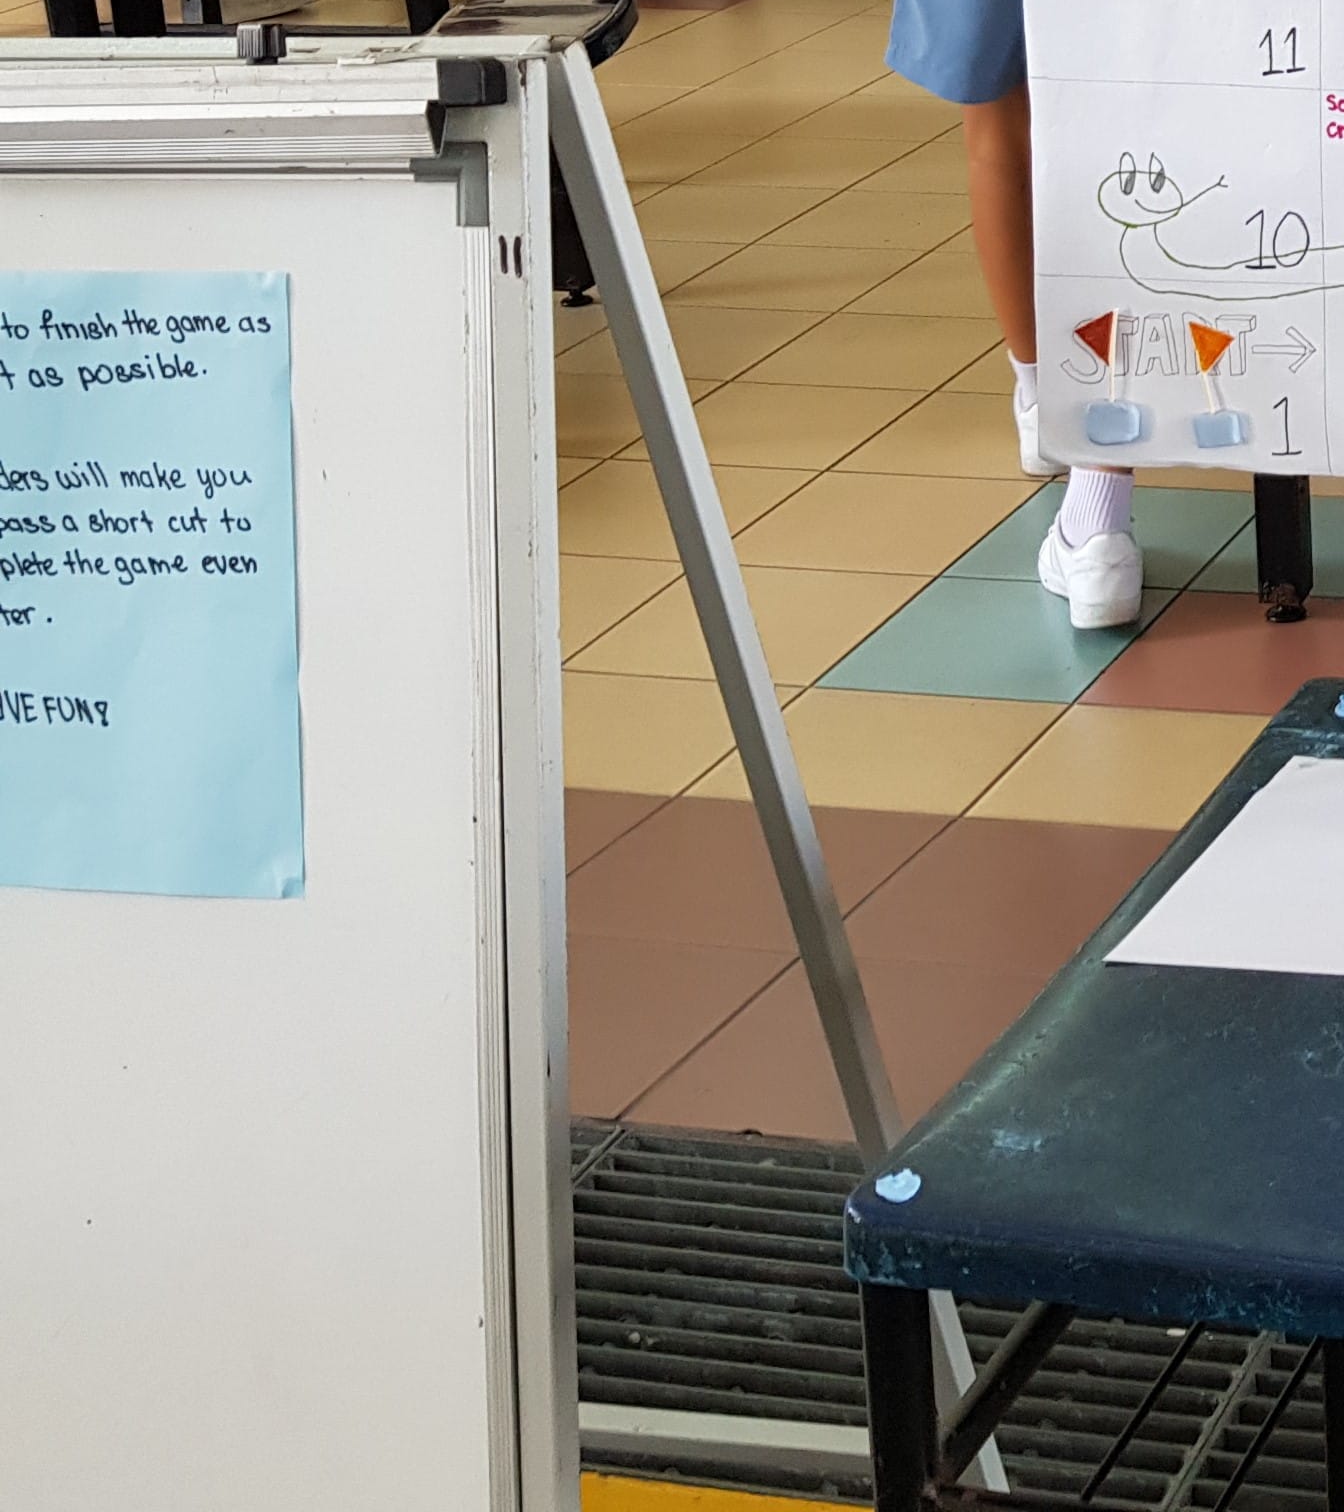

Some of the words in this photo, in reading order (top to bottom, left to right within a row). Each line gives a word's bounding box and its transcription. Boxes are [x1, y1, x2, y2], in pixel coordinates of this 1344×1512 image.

[1258, 26, 1307, 77] 11
[1244, 208, 1311, 271] 10
[0, 311, 30, 341] to
[39, 309, 119, 340] finish
[121, 308, 161, 337] the
[164, 314, 231, 344] game
[238, 316, 272, 335] as
[28, 368, 64, 389] as
[1271, 395, 1303, 457] 1
[55, 460, 110, 490] will
[119, 463, 187, 490] make
[196, 465, 253, 499] you
[61, 514, 79, 533] a
[88, 507, 154, 535] short
[167, 506, 208, 533] cut
[219, 507, 252, 533] to
[62, 548, 115, 576] the
[113, 551, 189, 586] game
[200, 553, 259, 576] even
